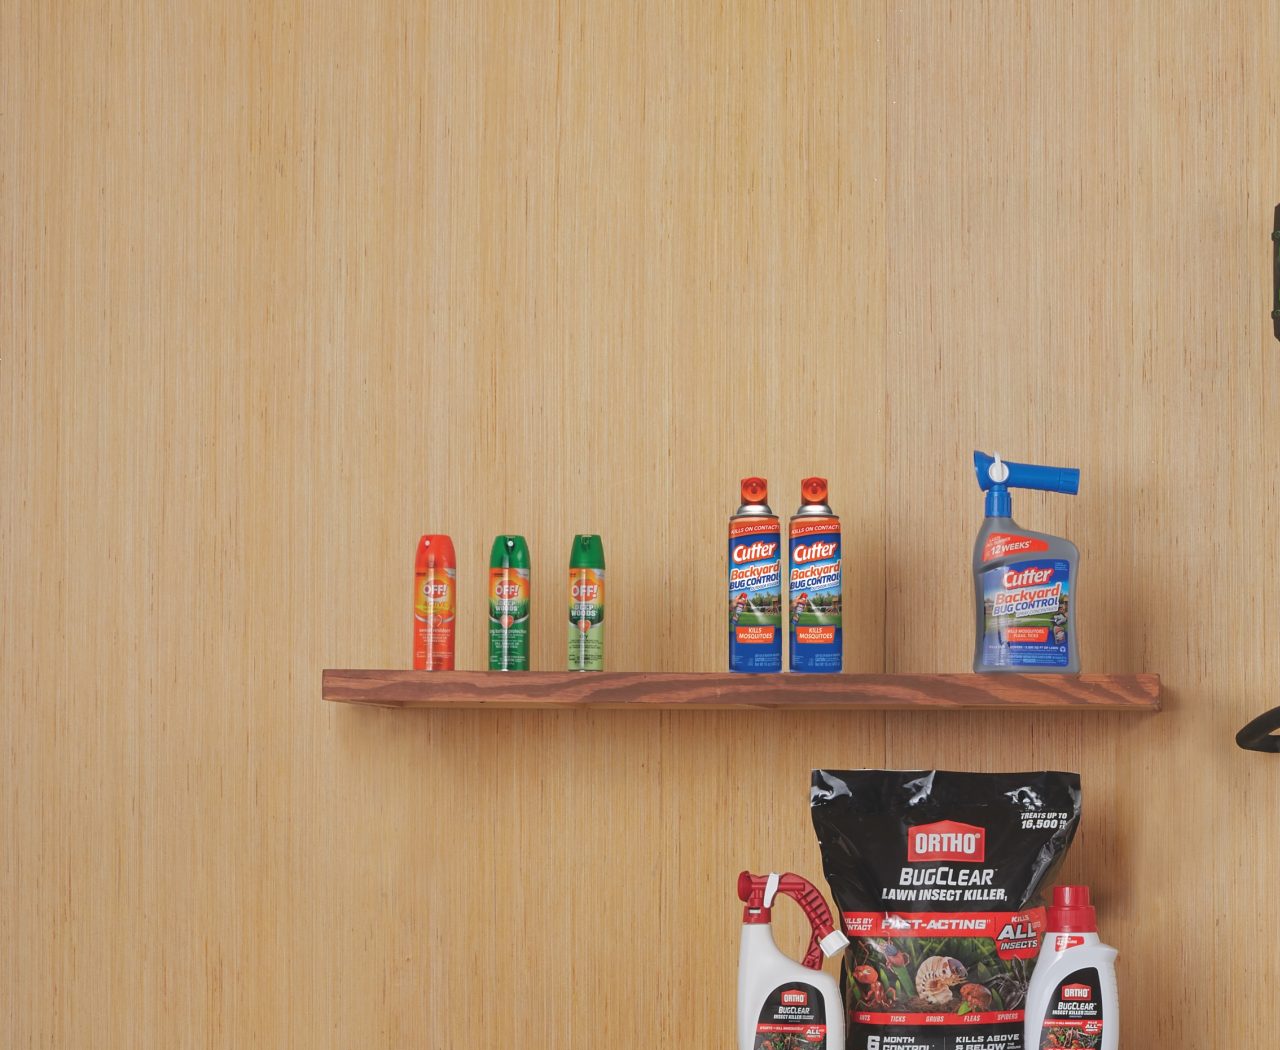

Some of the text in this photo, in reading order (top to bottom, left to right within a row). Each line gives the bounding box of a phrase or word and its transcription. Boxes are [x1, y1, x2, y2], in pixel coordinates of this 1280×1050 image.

[733, 543, 776, 562] Cutter
[794, 543, 836, 562] Cutter
[991, 545, 1001, 555] 12
[731, 561, 780, 580] Backyard
[792, 561, 840, 580] Backyard
[730, 574, 779, 589] BUG CONTROL
[790, 574, 839, 589] BUG CONTROL
[1004, 570, 1051, 587] Cutter
[423, 584, 448, 596] OFF!
[496, 584, 519, 596] OFF!
[572, 584, 598, 598] OFF!
[995, 584, 1060, 605] Backyard
[571, 609, 596, 617] WOODS
[994, 598, 1058, 615] BUG CONTROL
[1021, 819, 1058, 830] 16,500
[915, 832, 977, 854] ORTHO
[882, 887, 916, 901] LAWN
[918, 888, 962, 901] INSECT
[997, 923, 1037, 940] ALL
[1001, 940, 1038, 950] INSECTS
[784, 994, 804, 1003] ORTHO
[1064, 988, 1088, 997] ORTHO
[955, 1034, 1019, 1043] KILLS ABOVE
